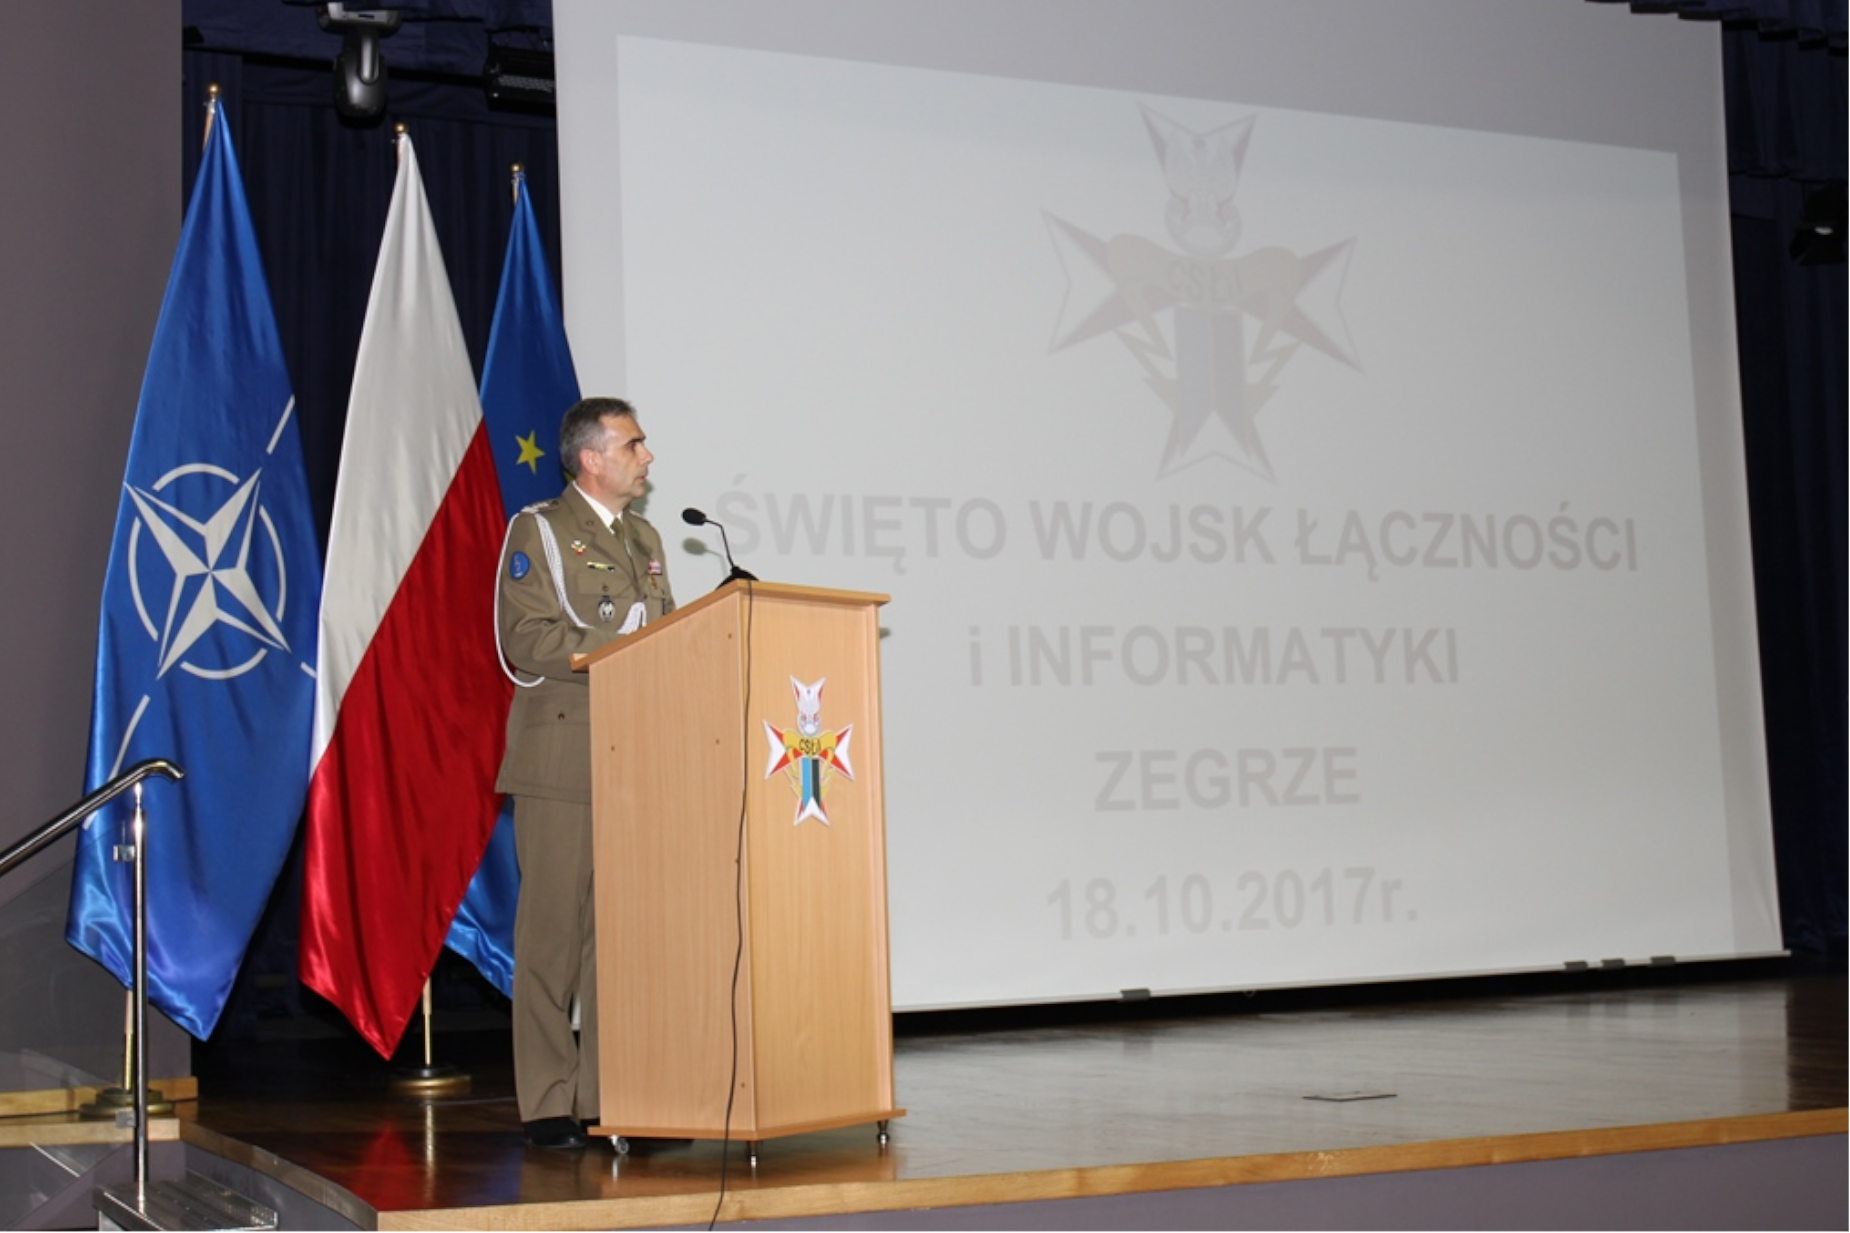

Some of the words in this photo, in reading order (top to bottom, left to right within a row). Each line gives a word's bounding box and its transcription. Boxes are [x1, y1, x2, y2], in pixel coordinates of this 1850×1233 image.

[715, 473, 1008, 575] ŚWIĘTO
[1028, 500, 1277, 564] WOJSK
[1295, 501, 1638, 582] ŁĄCZNOŚCI
[968, 625, 984, 687] i
[1009, 625, 1460, 687] INFORMATYKI
[1094, 746, 1361, 812] ZEGRZE
[1046, 866, 1418, 940] 18.10.2017r.
